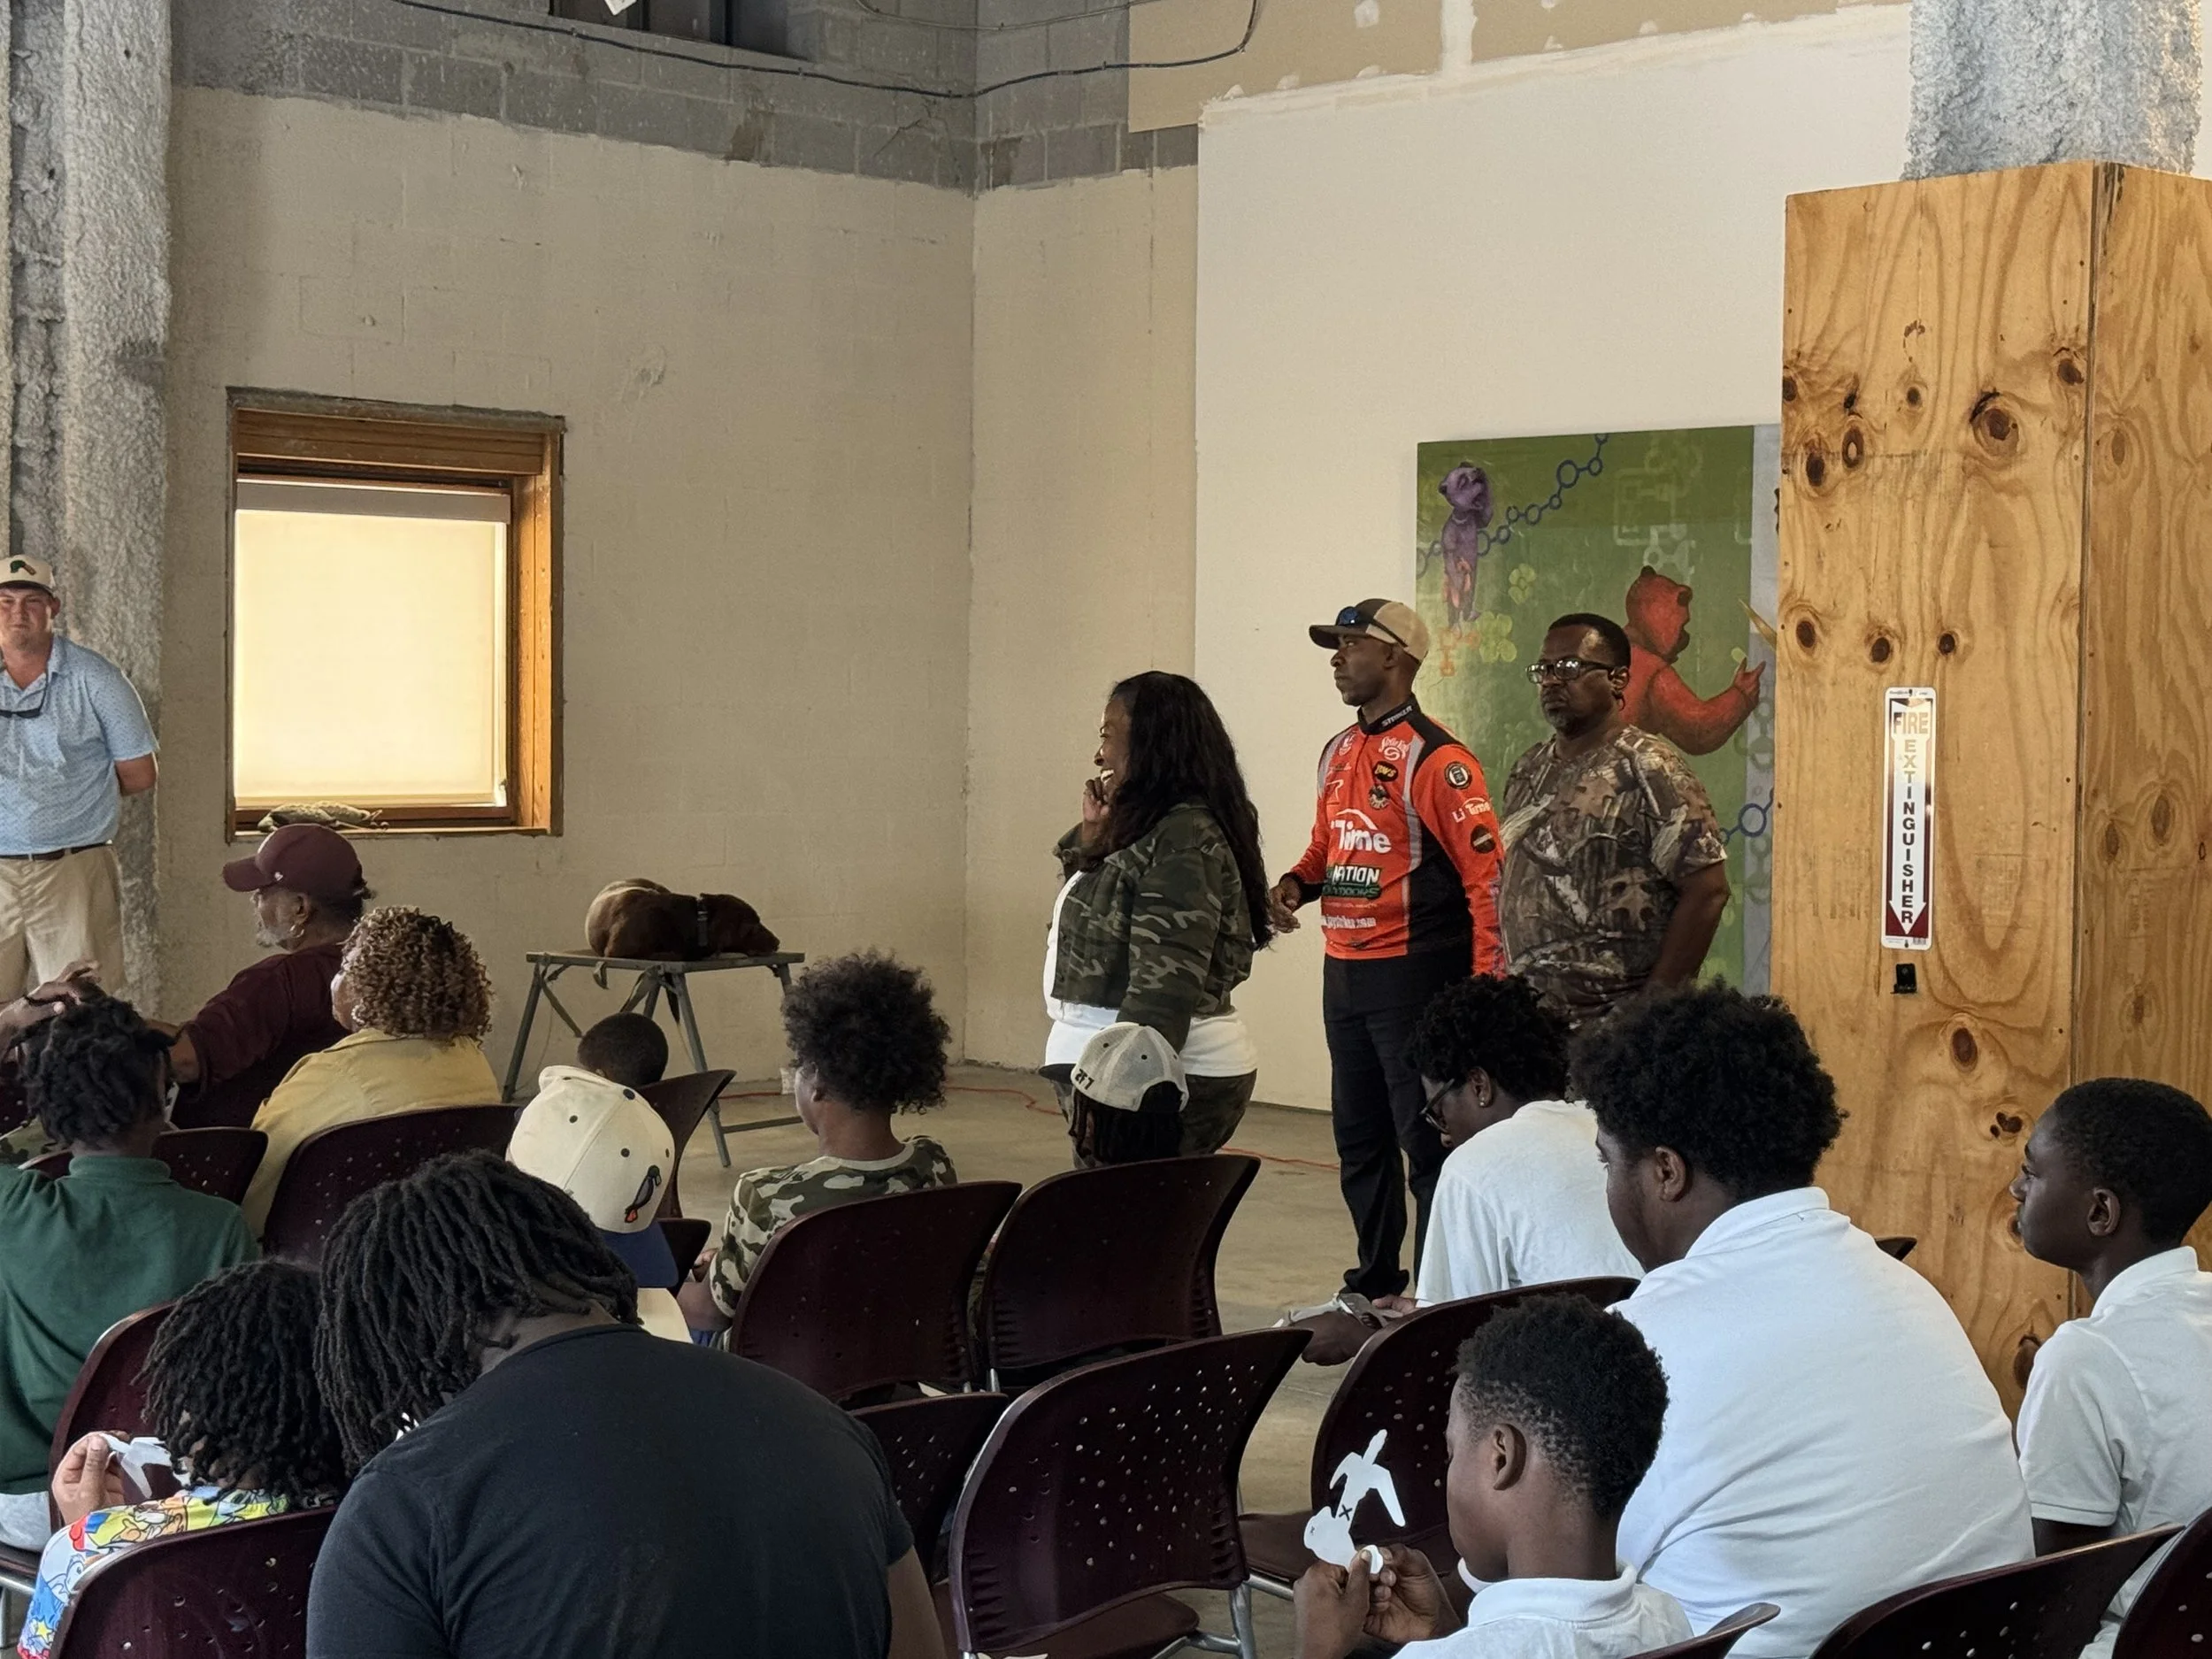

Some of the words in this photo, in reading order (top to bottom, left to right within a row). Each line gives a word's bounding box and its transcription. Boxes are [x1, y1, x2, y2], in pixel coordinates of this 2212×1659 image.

[1893, 711, 1929, 734] FIRE
[1335, 819, 1392, 854] Time
[1901, 739, 1916, 923] EXTINGUISHER
[1333, 865, 1380, 886] NATION
